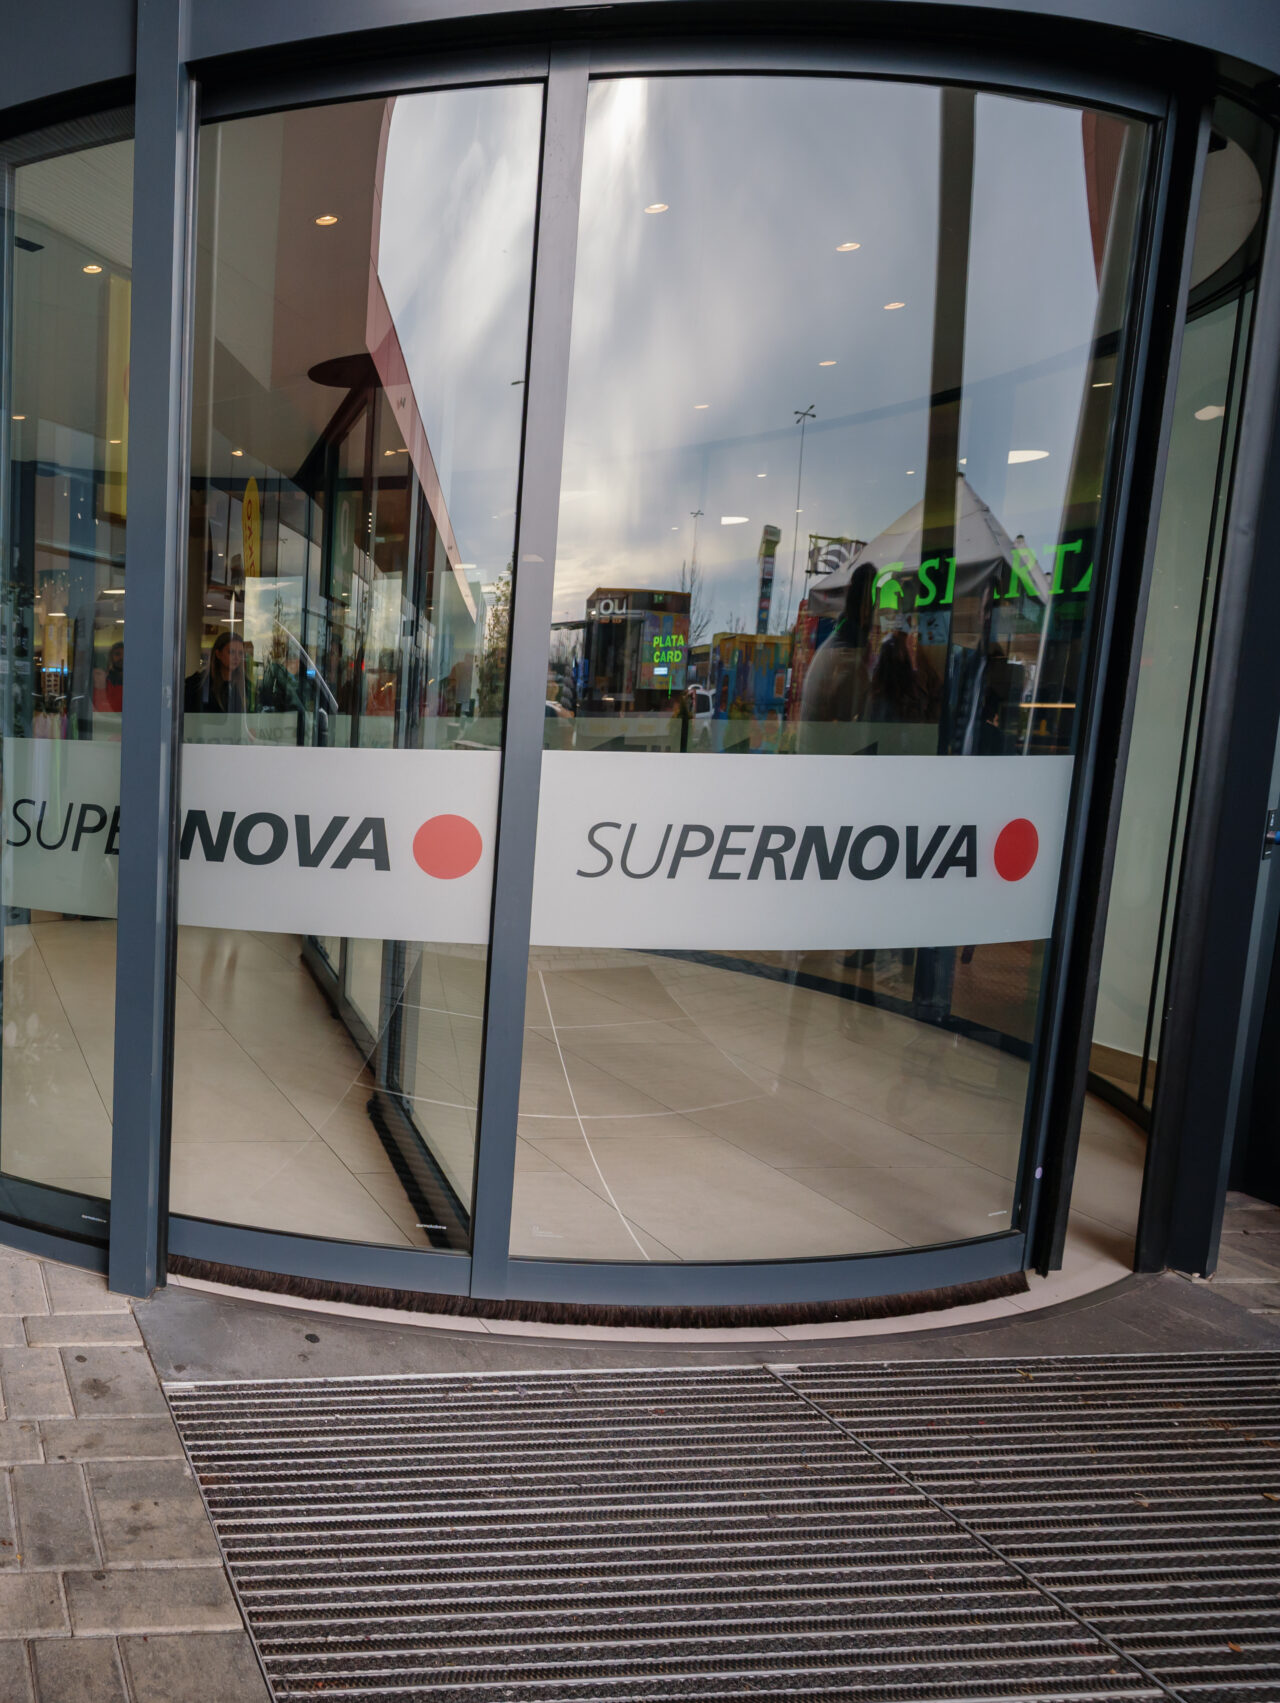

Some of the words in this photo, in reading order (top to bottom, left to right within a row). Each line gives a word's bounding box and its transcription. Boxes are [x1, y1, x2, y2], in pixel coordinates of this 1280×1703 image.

[653, 634, 685, 648] PLATA
[653, 650, 682, 663] CARD
[576, 821, 978, 881] SUPERNOVA
